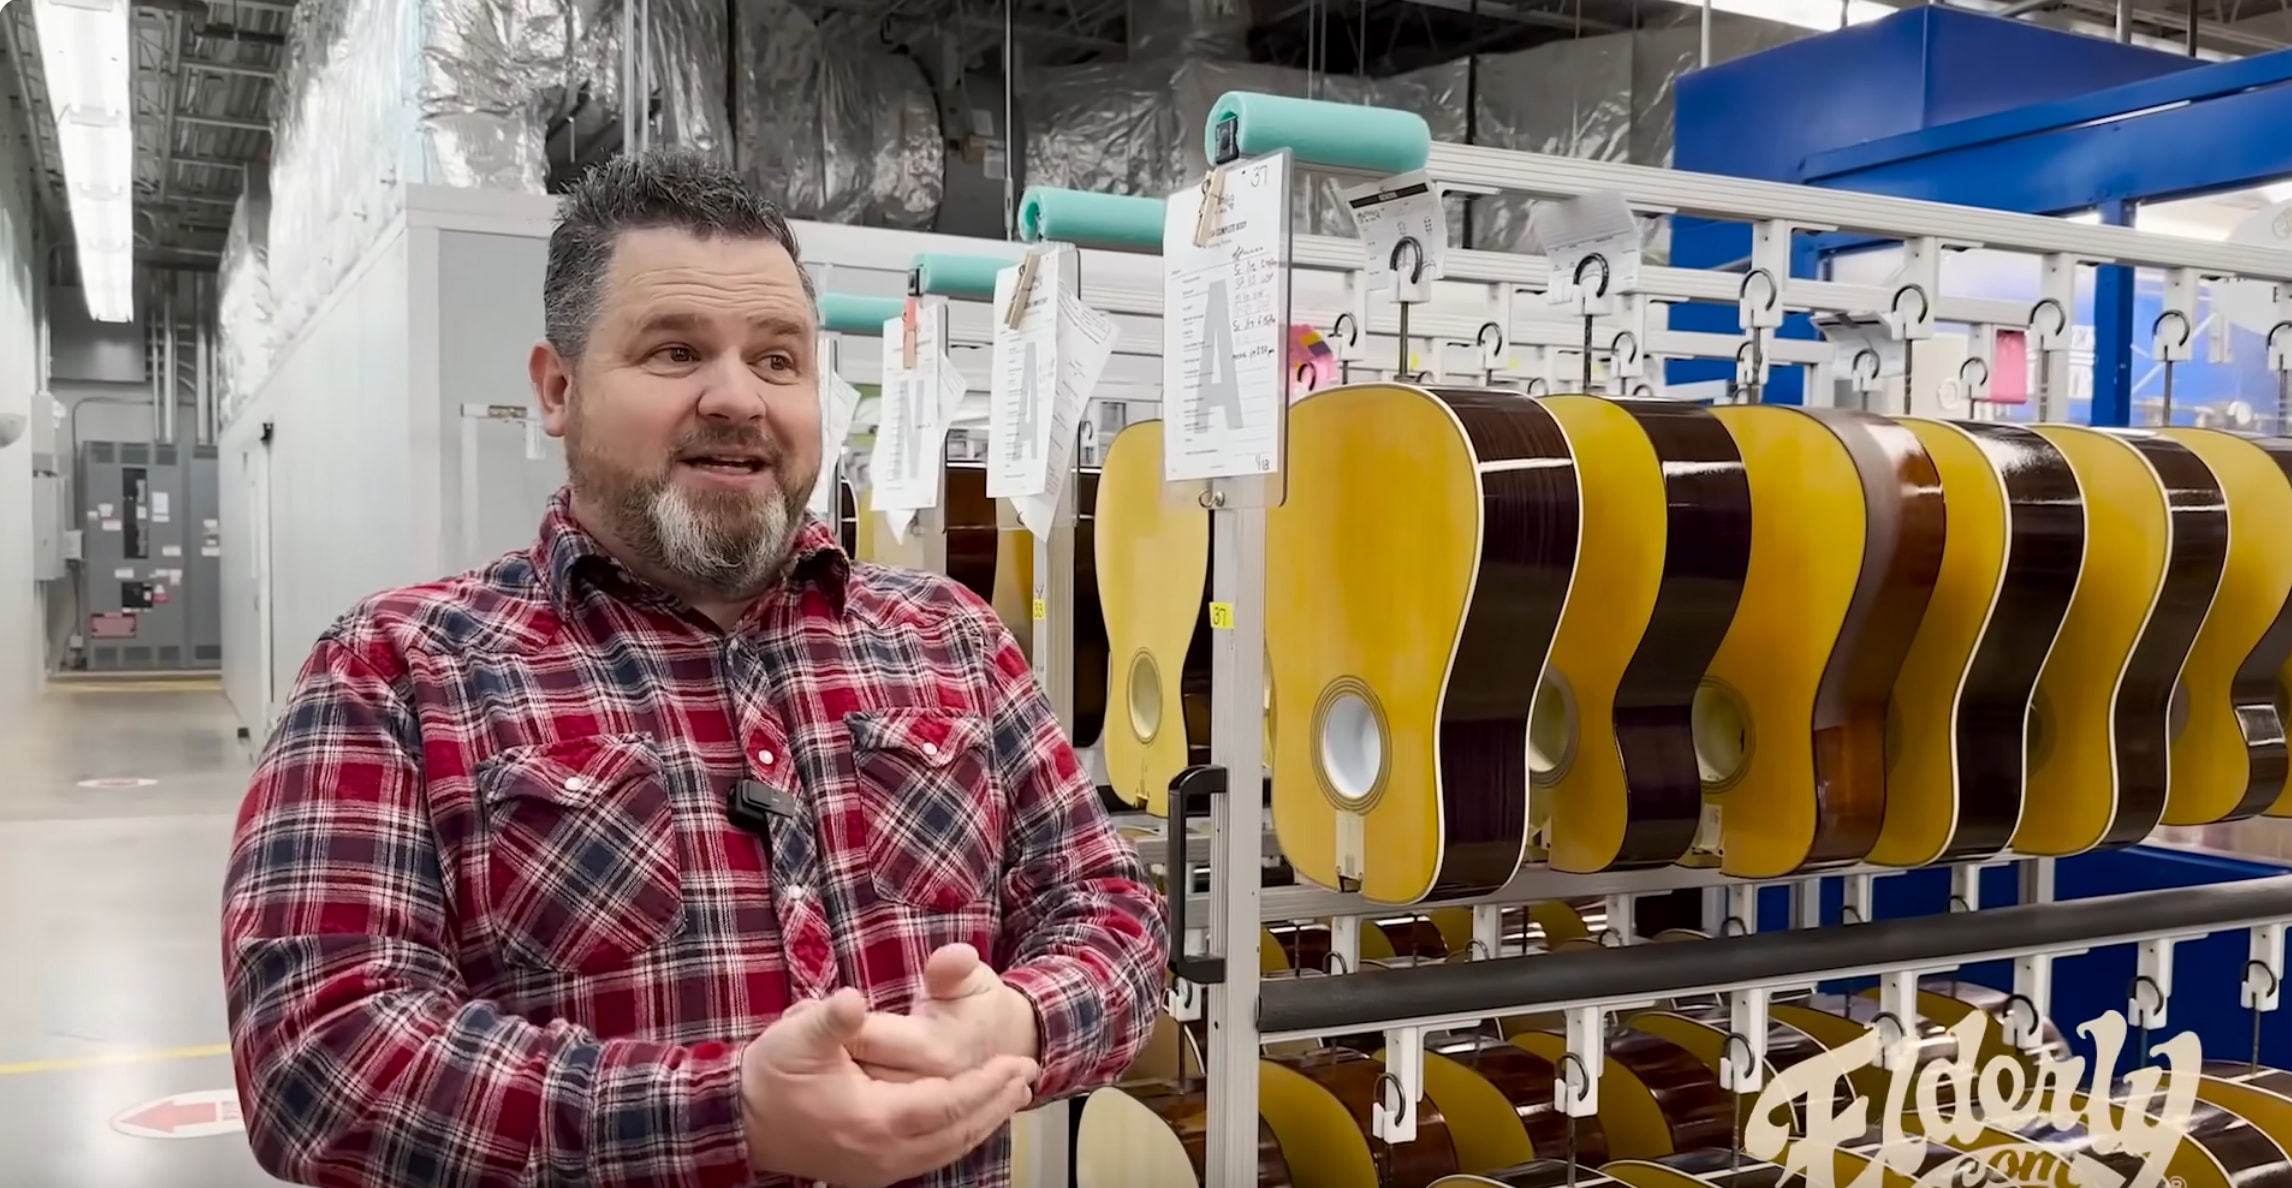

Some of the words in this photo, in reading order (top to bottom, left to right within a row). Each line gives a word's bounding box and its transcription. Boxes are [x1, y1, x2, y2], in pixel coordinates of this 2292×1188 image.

[1013, 341, 1038, 462] A
[1194, 278, 1244, 434] A
[1213, 606, 1227, 626] 37
